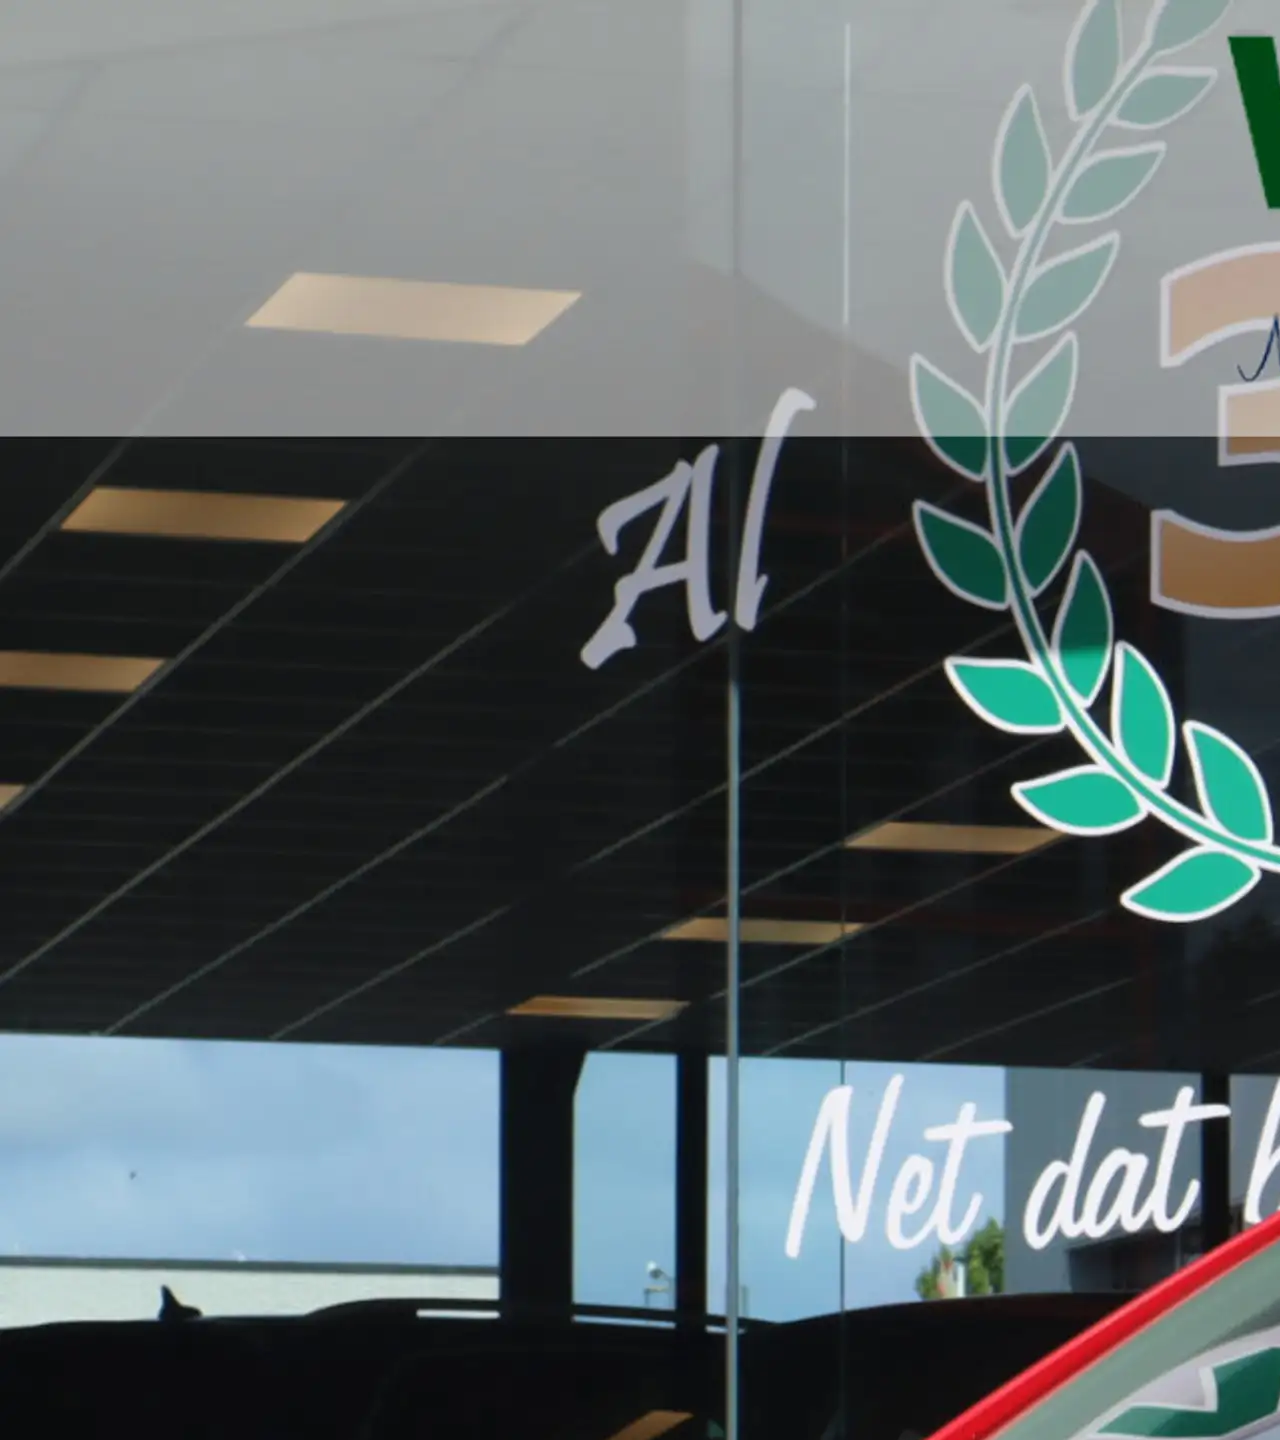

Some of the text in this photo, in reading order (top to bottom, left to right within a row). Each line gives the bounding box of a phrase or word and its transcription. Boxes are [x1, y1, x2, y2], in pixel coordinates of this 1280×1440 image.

[581, 388, 815, 669] Al
[784, 1073, 1012, 1258] Net
[1023, 1086, 1231, 1250] dat
